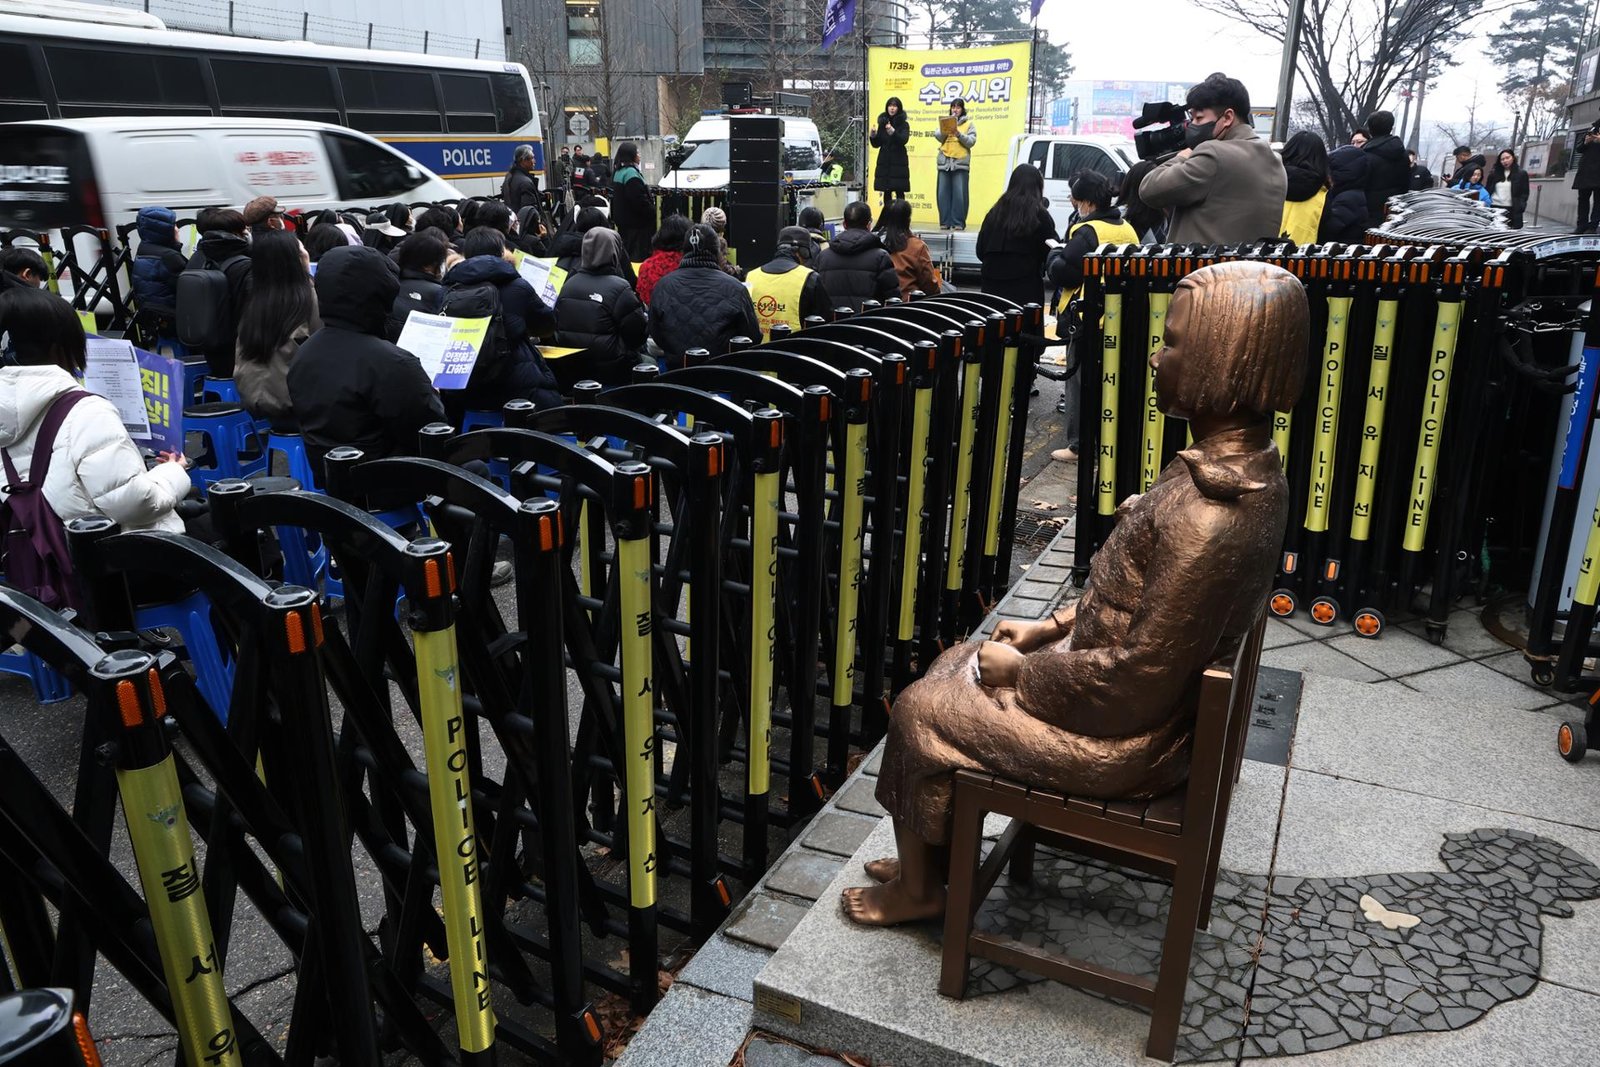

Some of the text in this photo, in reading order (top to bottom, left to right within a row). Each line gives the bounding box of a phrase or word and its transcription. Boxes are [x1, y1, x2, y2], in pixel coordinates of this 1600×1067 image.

[889, 61, 914, 70] 1739차
[919, 77, 1012, 105] 수요시위
[996, 61, 1010, 71] 위한
[443, 149, 492, 166] POLICE
[1099, 335, 1118, 493] 질서유지선
[1314, 342, 1339, 508] POLICE LINE
[1354, 345, 1389, 517] 질서유지선
[1411, 350, 1447, 527] POLICE LINE
[446, 716, 492, 1012] POLICE LINE
